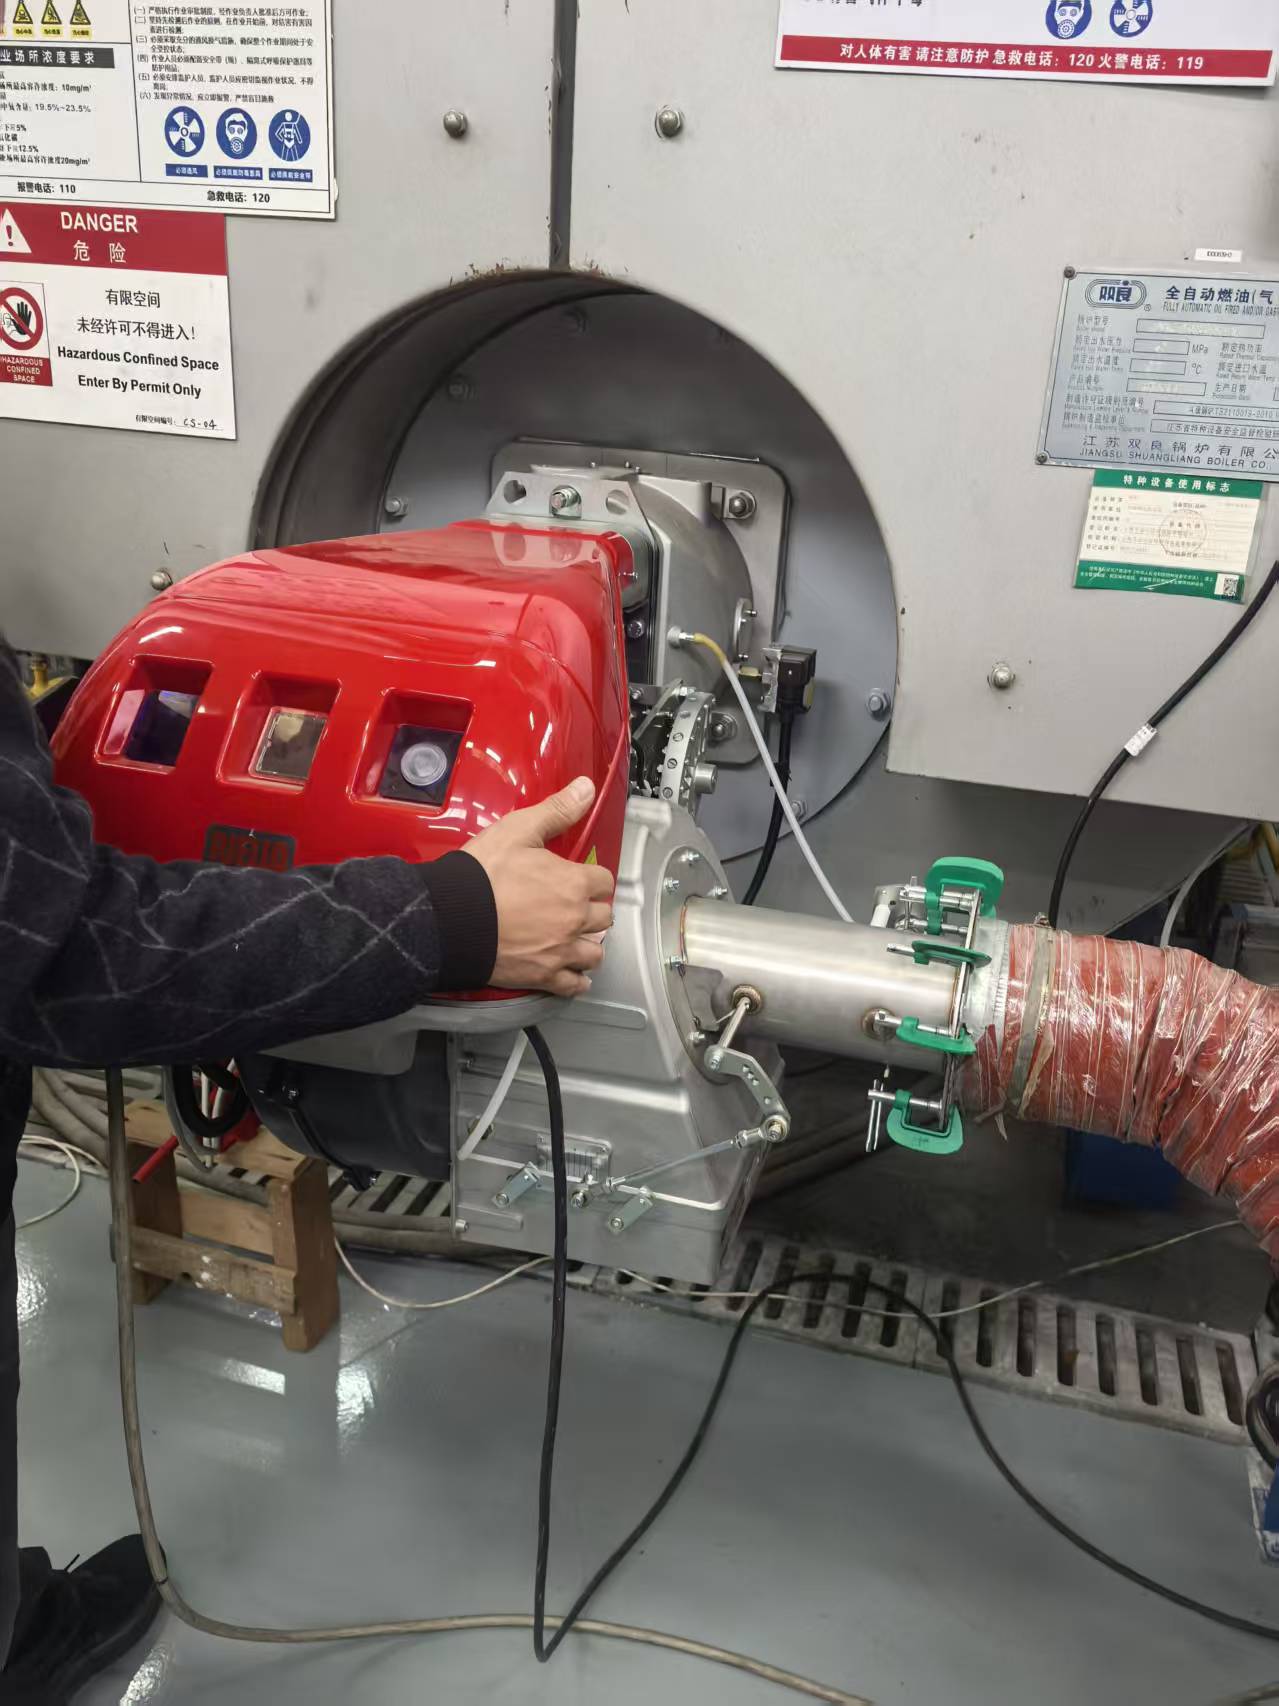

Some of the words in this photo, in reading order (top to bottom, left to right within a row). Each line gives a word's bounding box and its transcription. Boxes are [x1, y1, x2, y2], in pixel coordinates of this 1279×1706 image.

[840, 44, 912, 61] 对人体有害
[916, 46, 989, 64] 请注意防护
[60, 211, 139, 233] DANGER
[74, 240, 127, 263] 危险
[104, 288, 161, 309] 有限空间
[1181, 302, 1212, 314] AUTOMATIC
[57, 346, 121, 363] Hazardous
[123, 351, 179, 367] Confined
[181, 356, 219, 371] Space
[1192, 344, 1209, 355] MPa
[6, 366, 41, 375] CONFINED
[13, 374, 35, 383] SPACE
[78, 375, 110, 388] Enter
[112, 378, 128, 392] By
[131, 379, 171, 394] Permit
[173, 383, 202, 399] Only
[184, 418, 217, 430] CS-04
[1080, 448, 1122, 459] JIANGSU
[1128, 452, 1201, 465] SHUANGLIANG
[1207, 458, 1245, 469] BOILER
[1123, 475, 1231, 493] 特种设备使用标志
